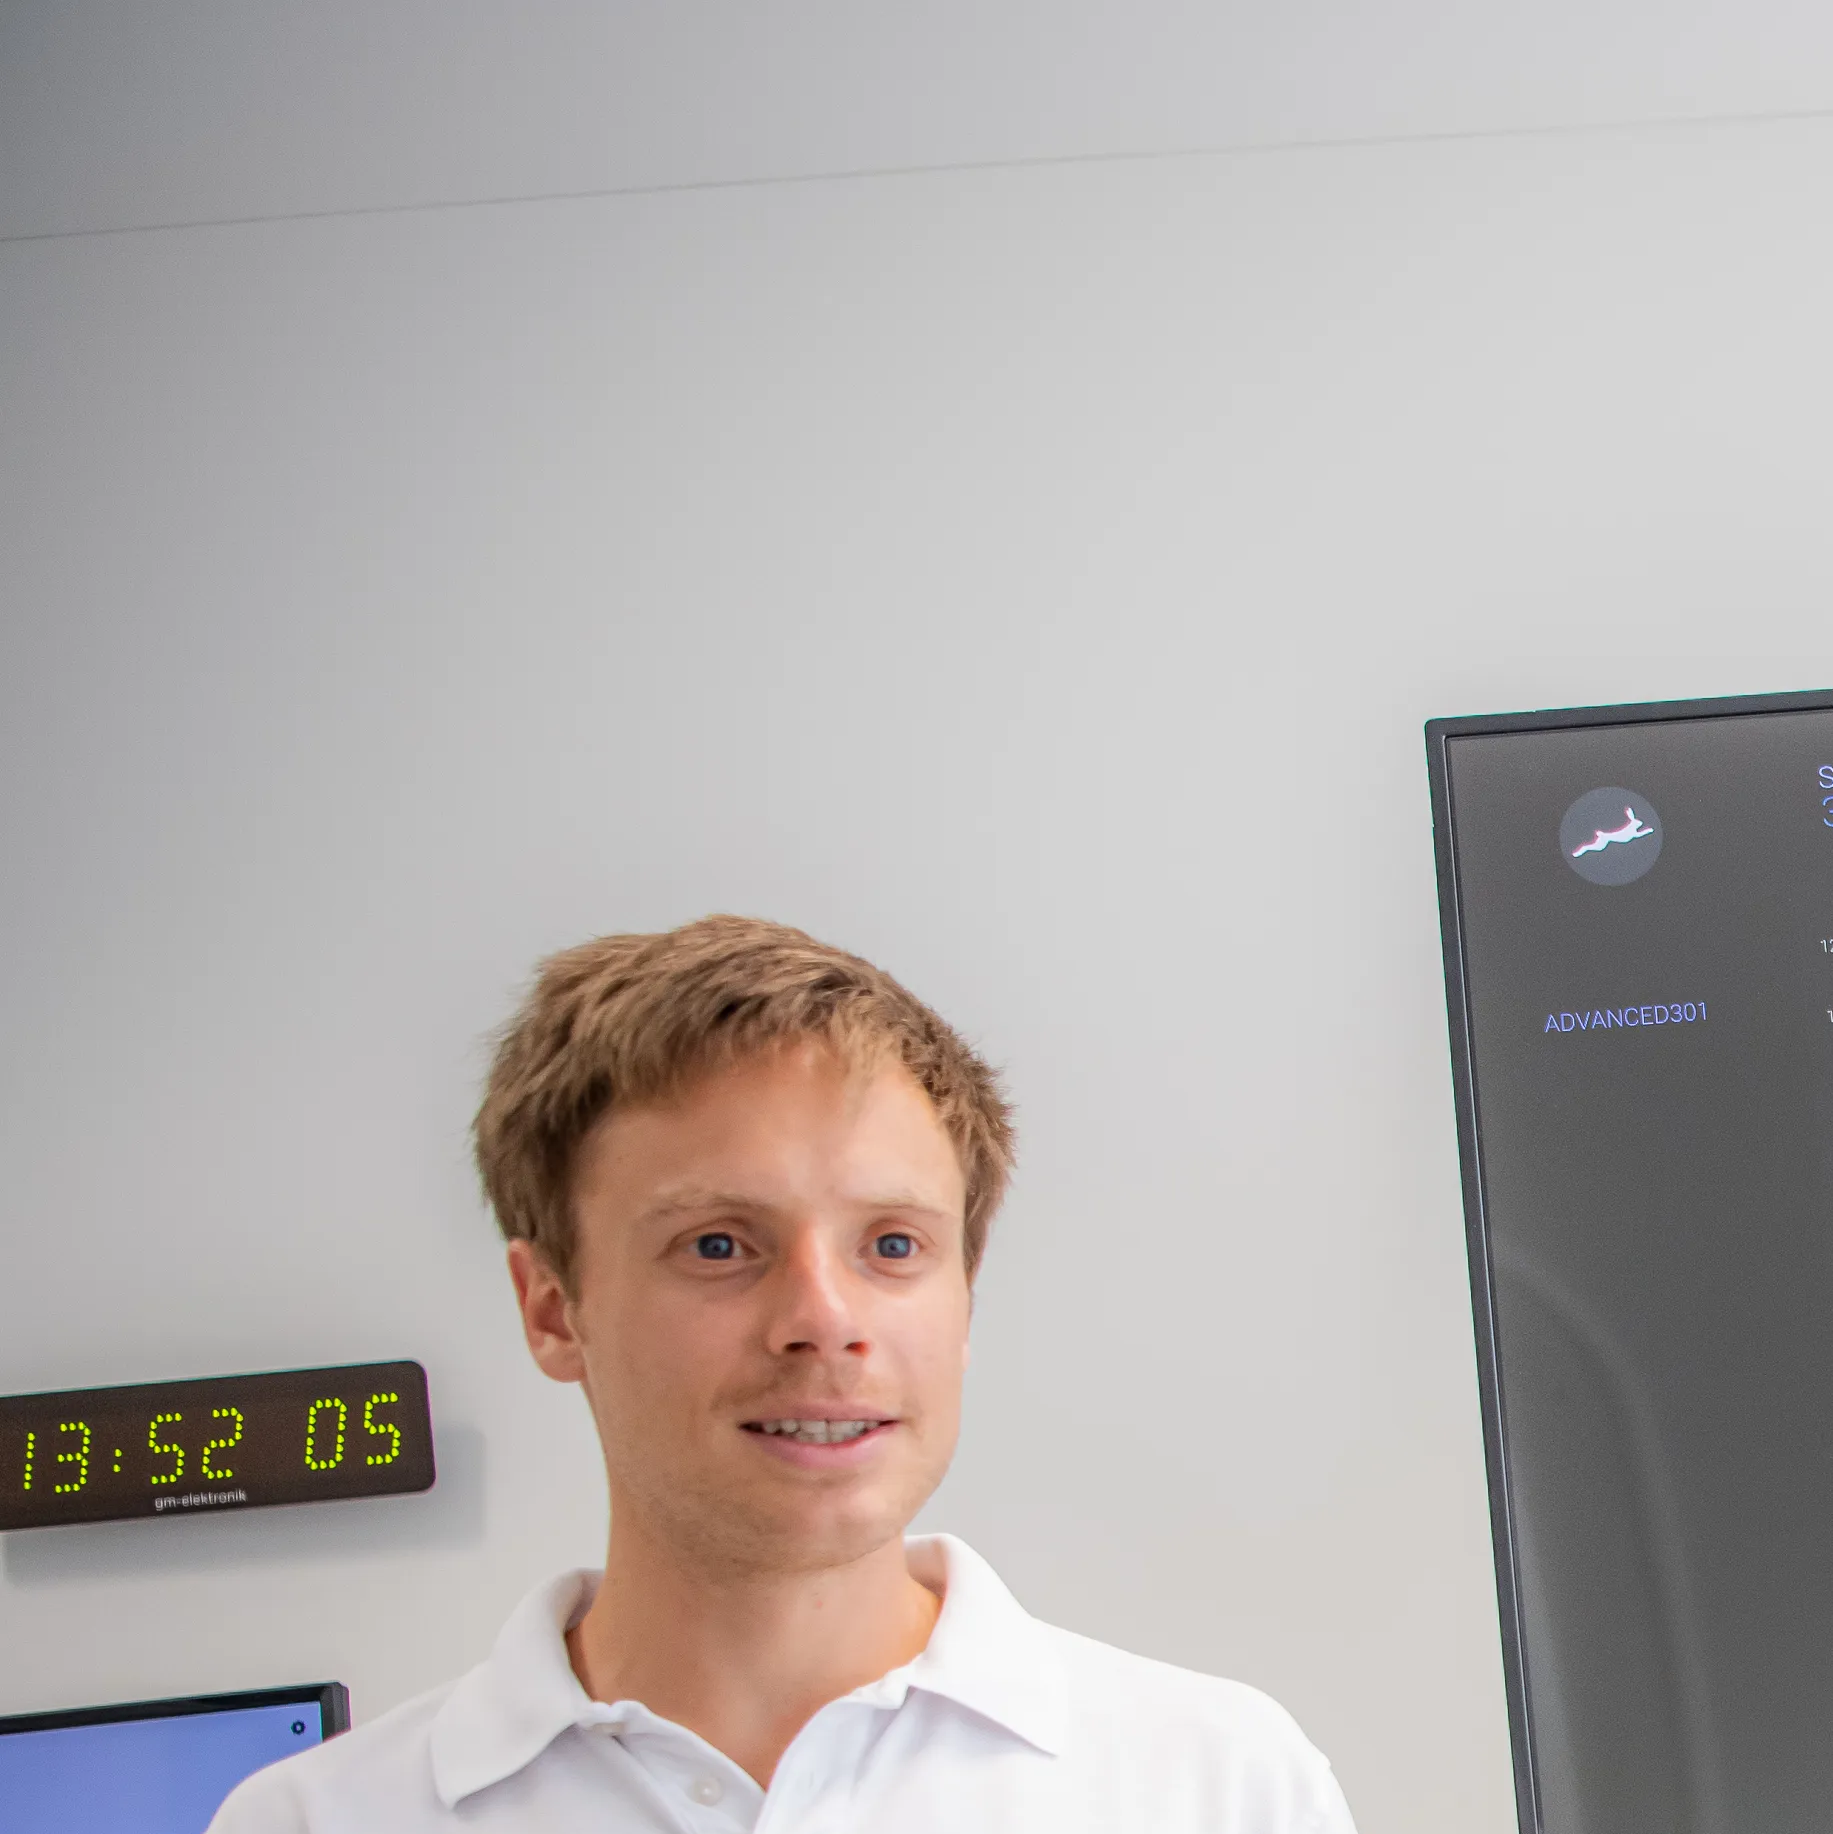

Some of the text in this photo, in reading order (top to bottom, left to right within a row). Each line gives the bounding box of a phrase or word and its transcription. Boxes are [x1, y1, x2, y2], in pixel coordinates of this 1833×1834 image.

[1544, 1002, 1708, 1034] ADVANCED301
[23, 1393, 401, 1493] 13:52 05
[155, 1488, 247, 1511] gm-elektronik
